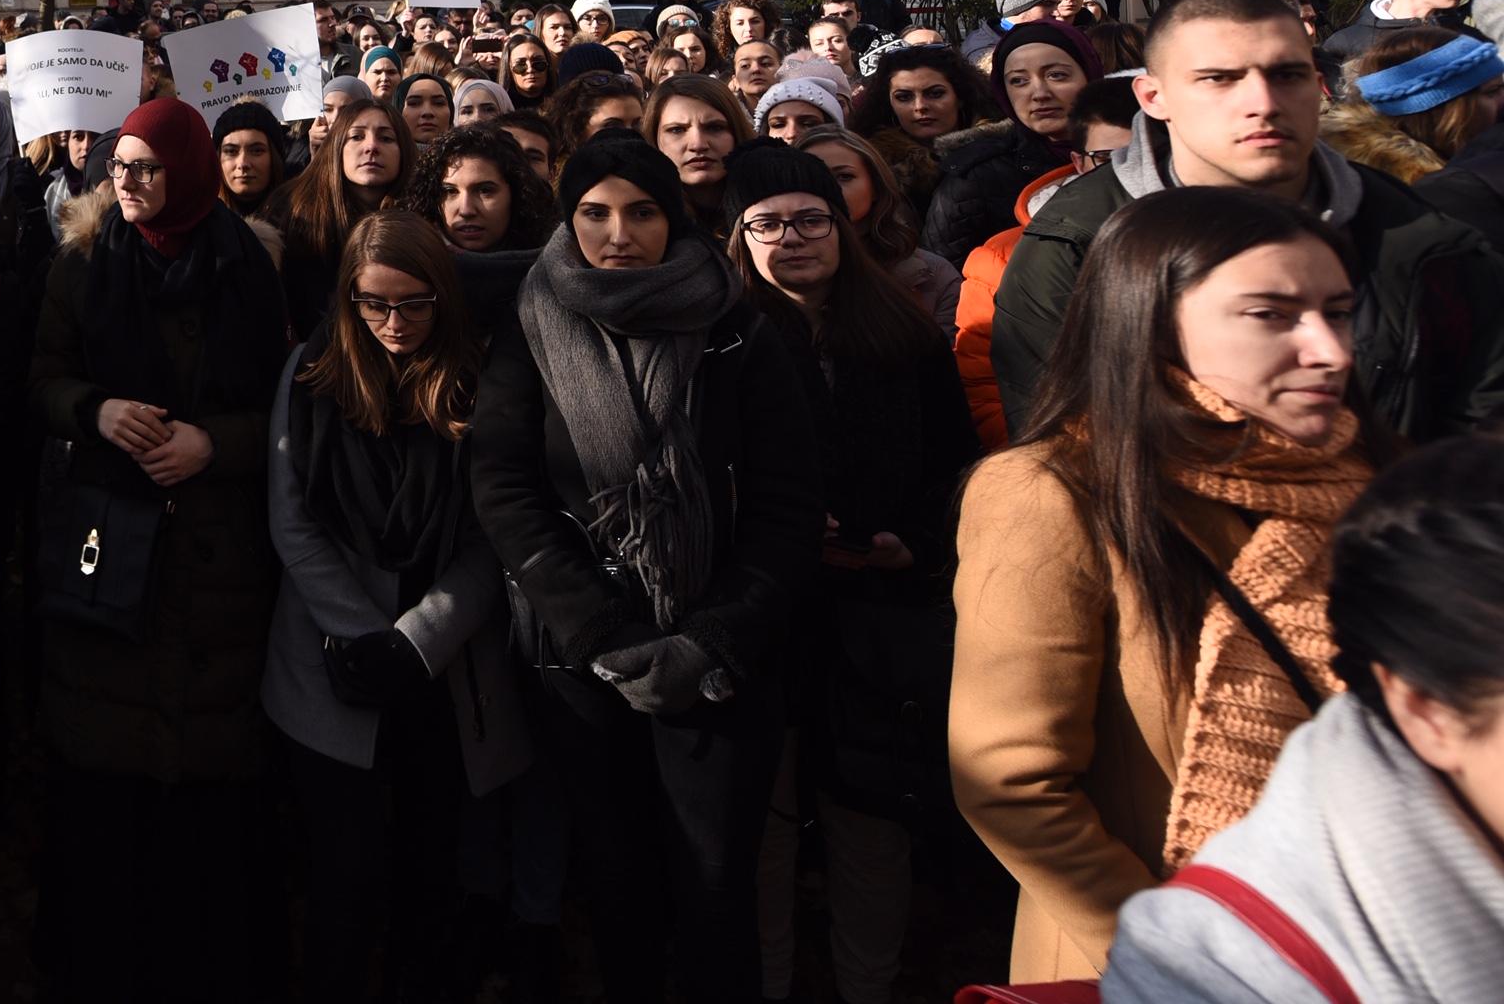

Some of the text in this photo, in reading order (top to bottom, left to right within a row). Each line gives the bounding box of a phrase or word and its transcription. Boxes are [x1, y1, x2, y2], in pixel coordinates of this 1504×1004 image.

[46, 58, 55, 68] JE
[57, 57, 88, 66] SAMO
[90, 58, 104, 68] DA
[52, 87, 65, 96] NE
[67, 86, 93, 96] DAJU
[201, 96, 231, 109] PRAVO
[247, 84, 302, 97] OBRAZOVANJE
